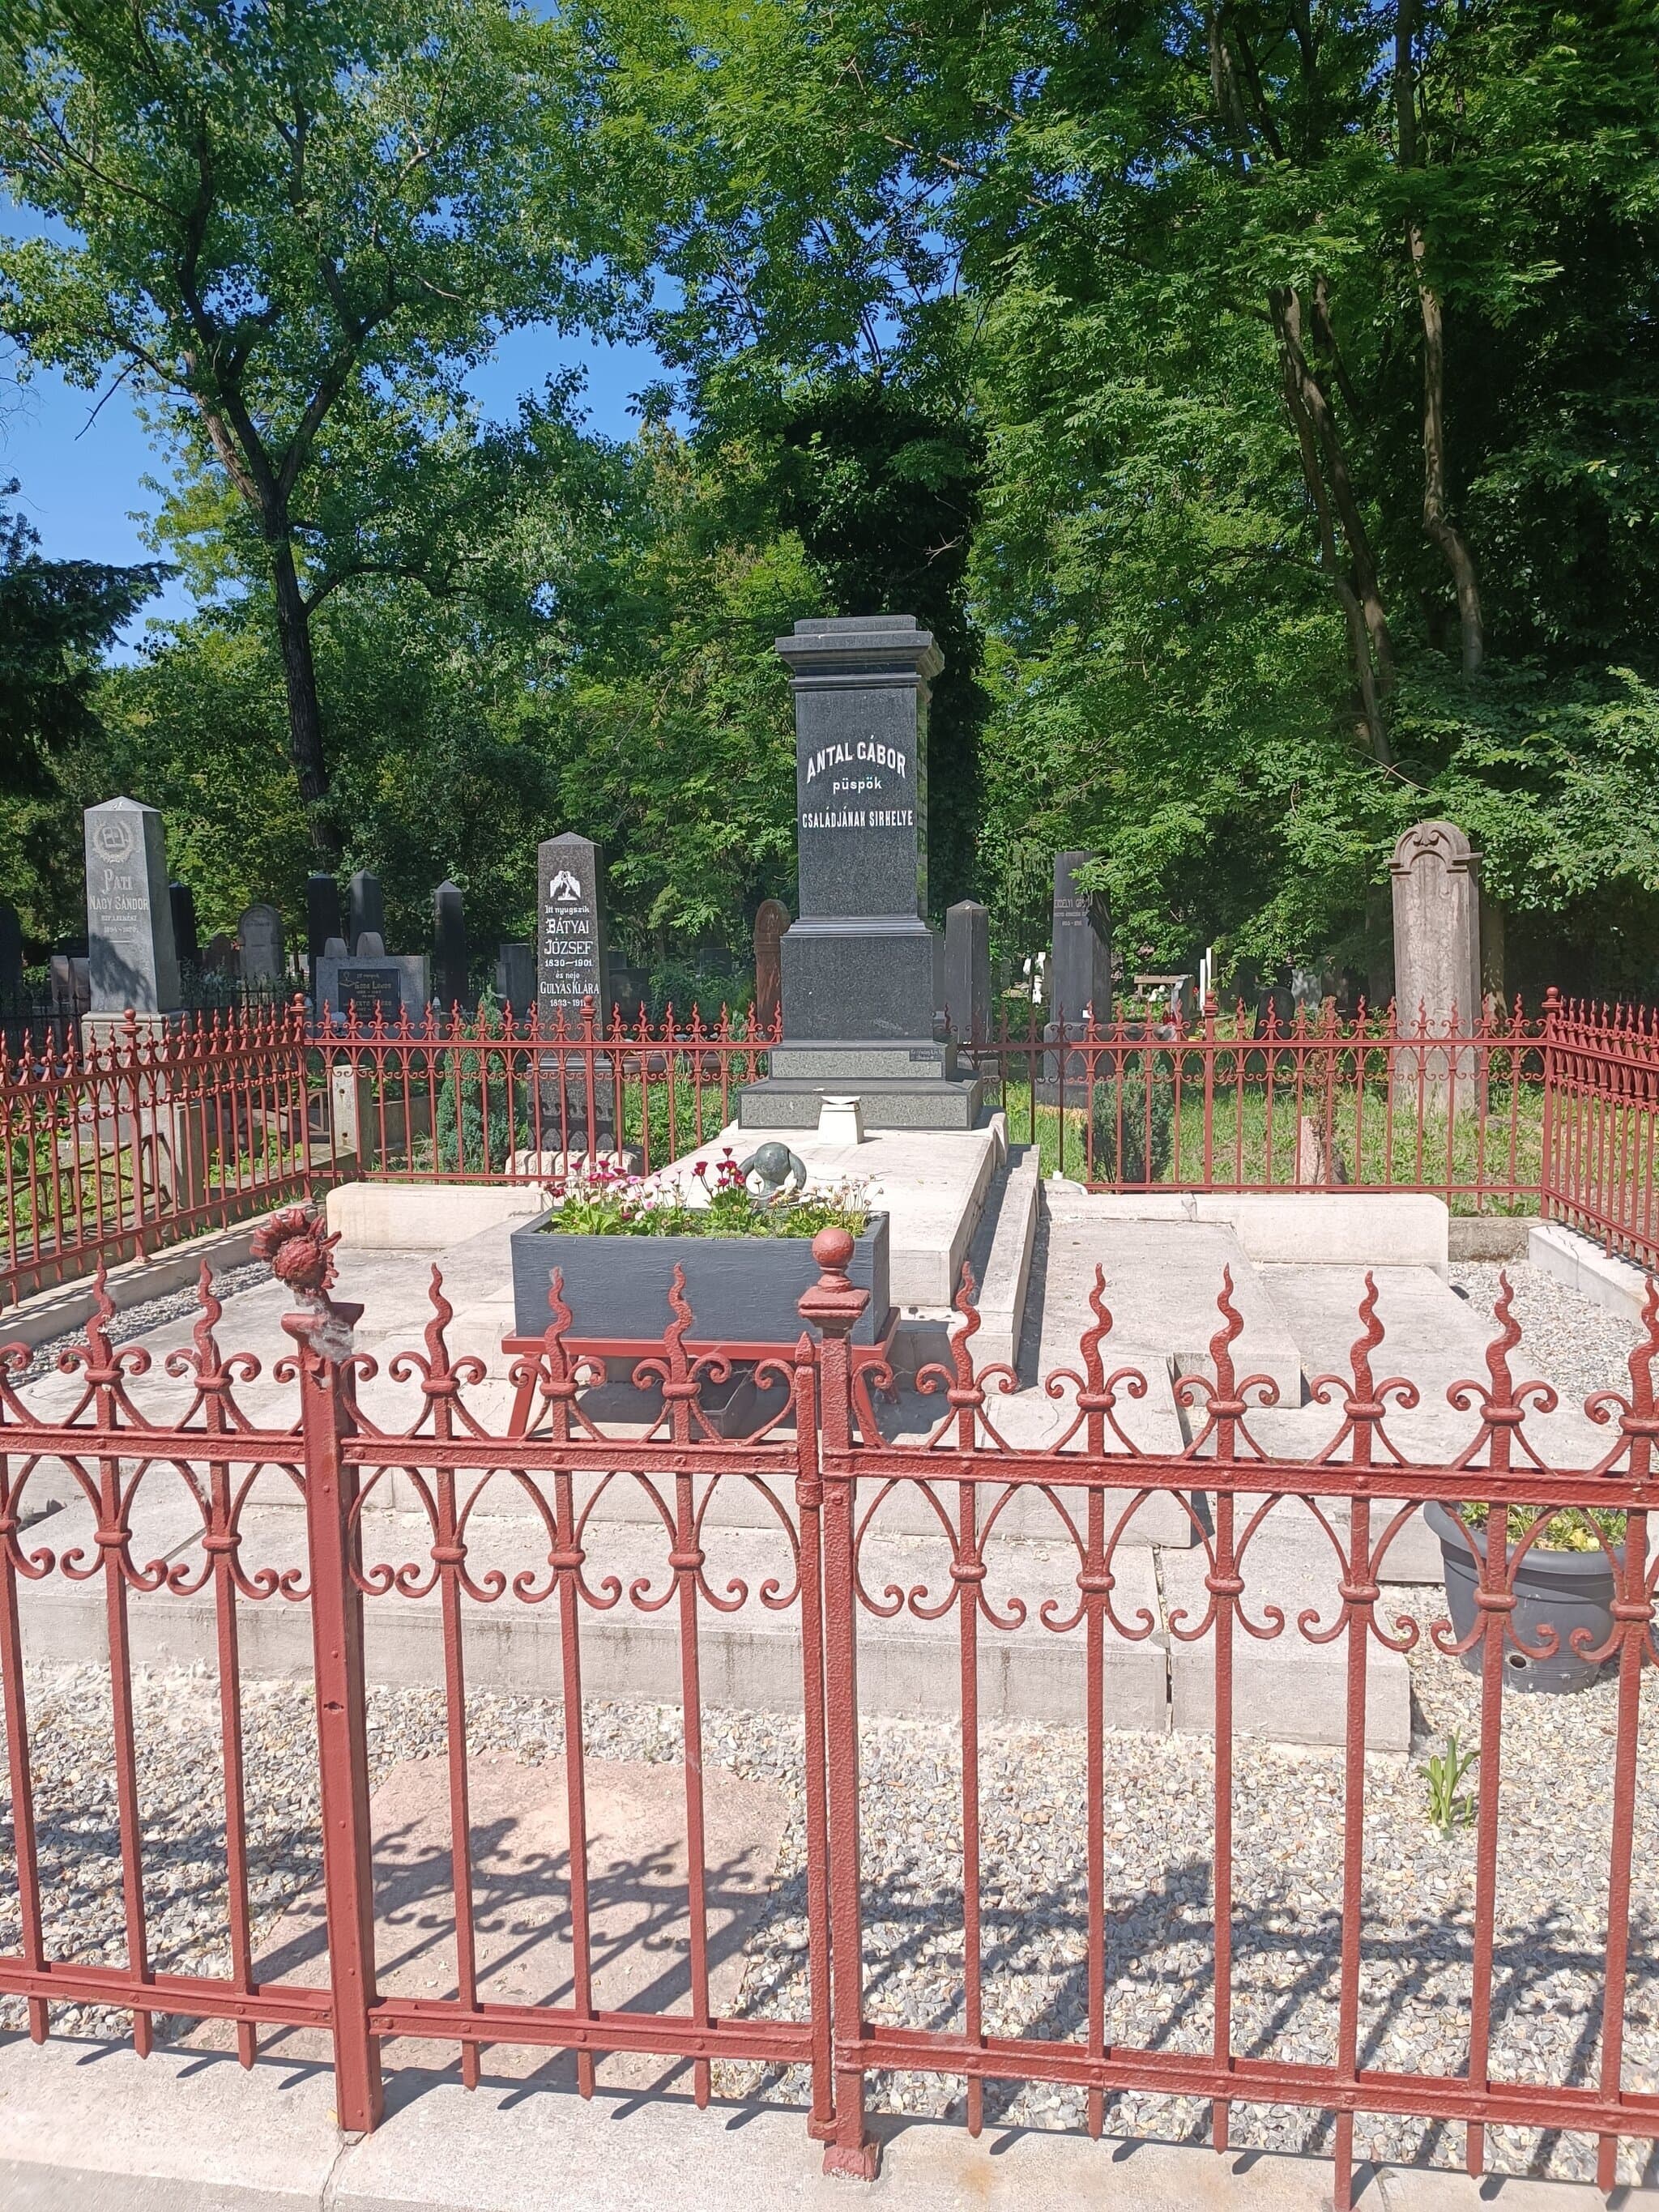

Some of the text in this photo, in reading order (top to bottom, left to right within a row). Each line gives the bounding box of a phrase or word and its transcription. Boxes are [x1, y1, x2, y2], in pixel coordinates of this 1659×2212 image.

[807, 735, 906, 784] ANTAL GÁBOR
[833, 776, 882, 795] püspök
[802, 806, 914, 828] CSALÁDJÁNAK SIRHELYE
[115, 893, 149, 910] SÁNDOR
[545, 905, 590, 915] Itt nyugszik
[546, 918, 589, 934] BÁTYAI
[544, 938, 593, 955] JÓZSEF
[556, 970, 581, 980] és neje
[540, 978, 599, 995] GULYÁS KLÁRA
